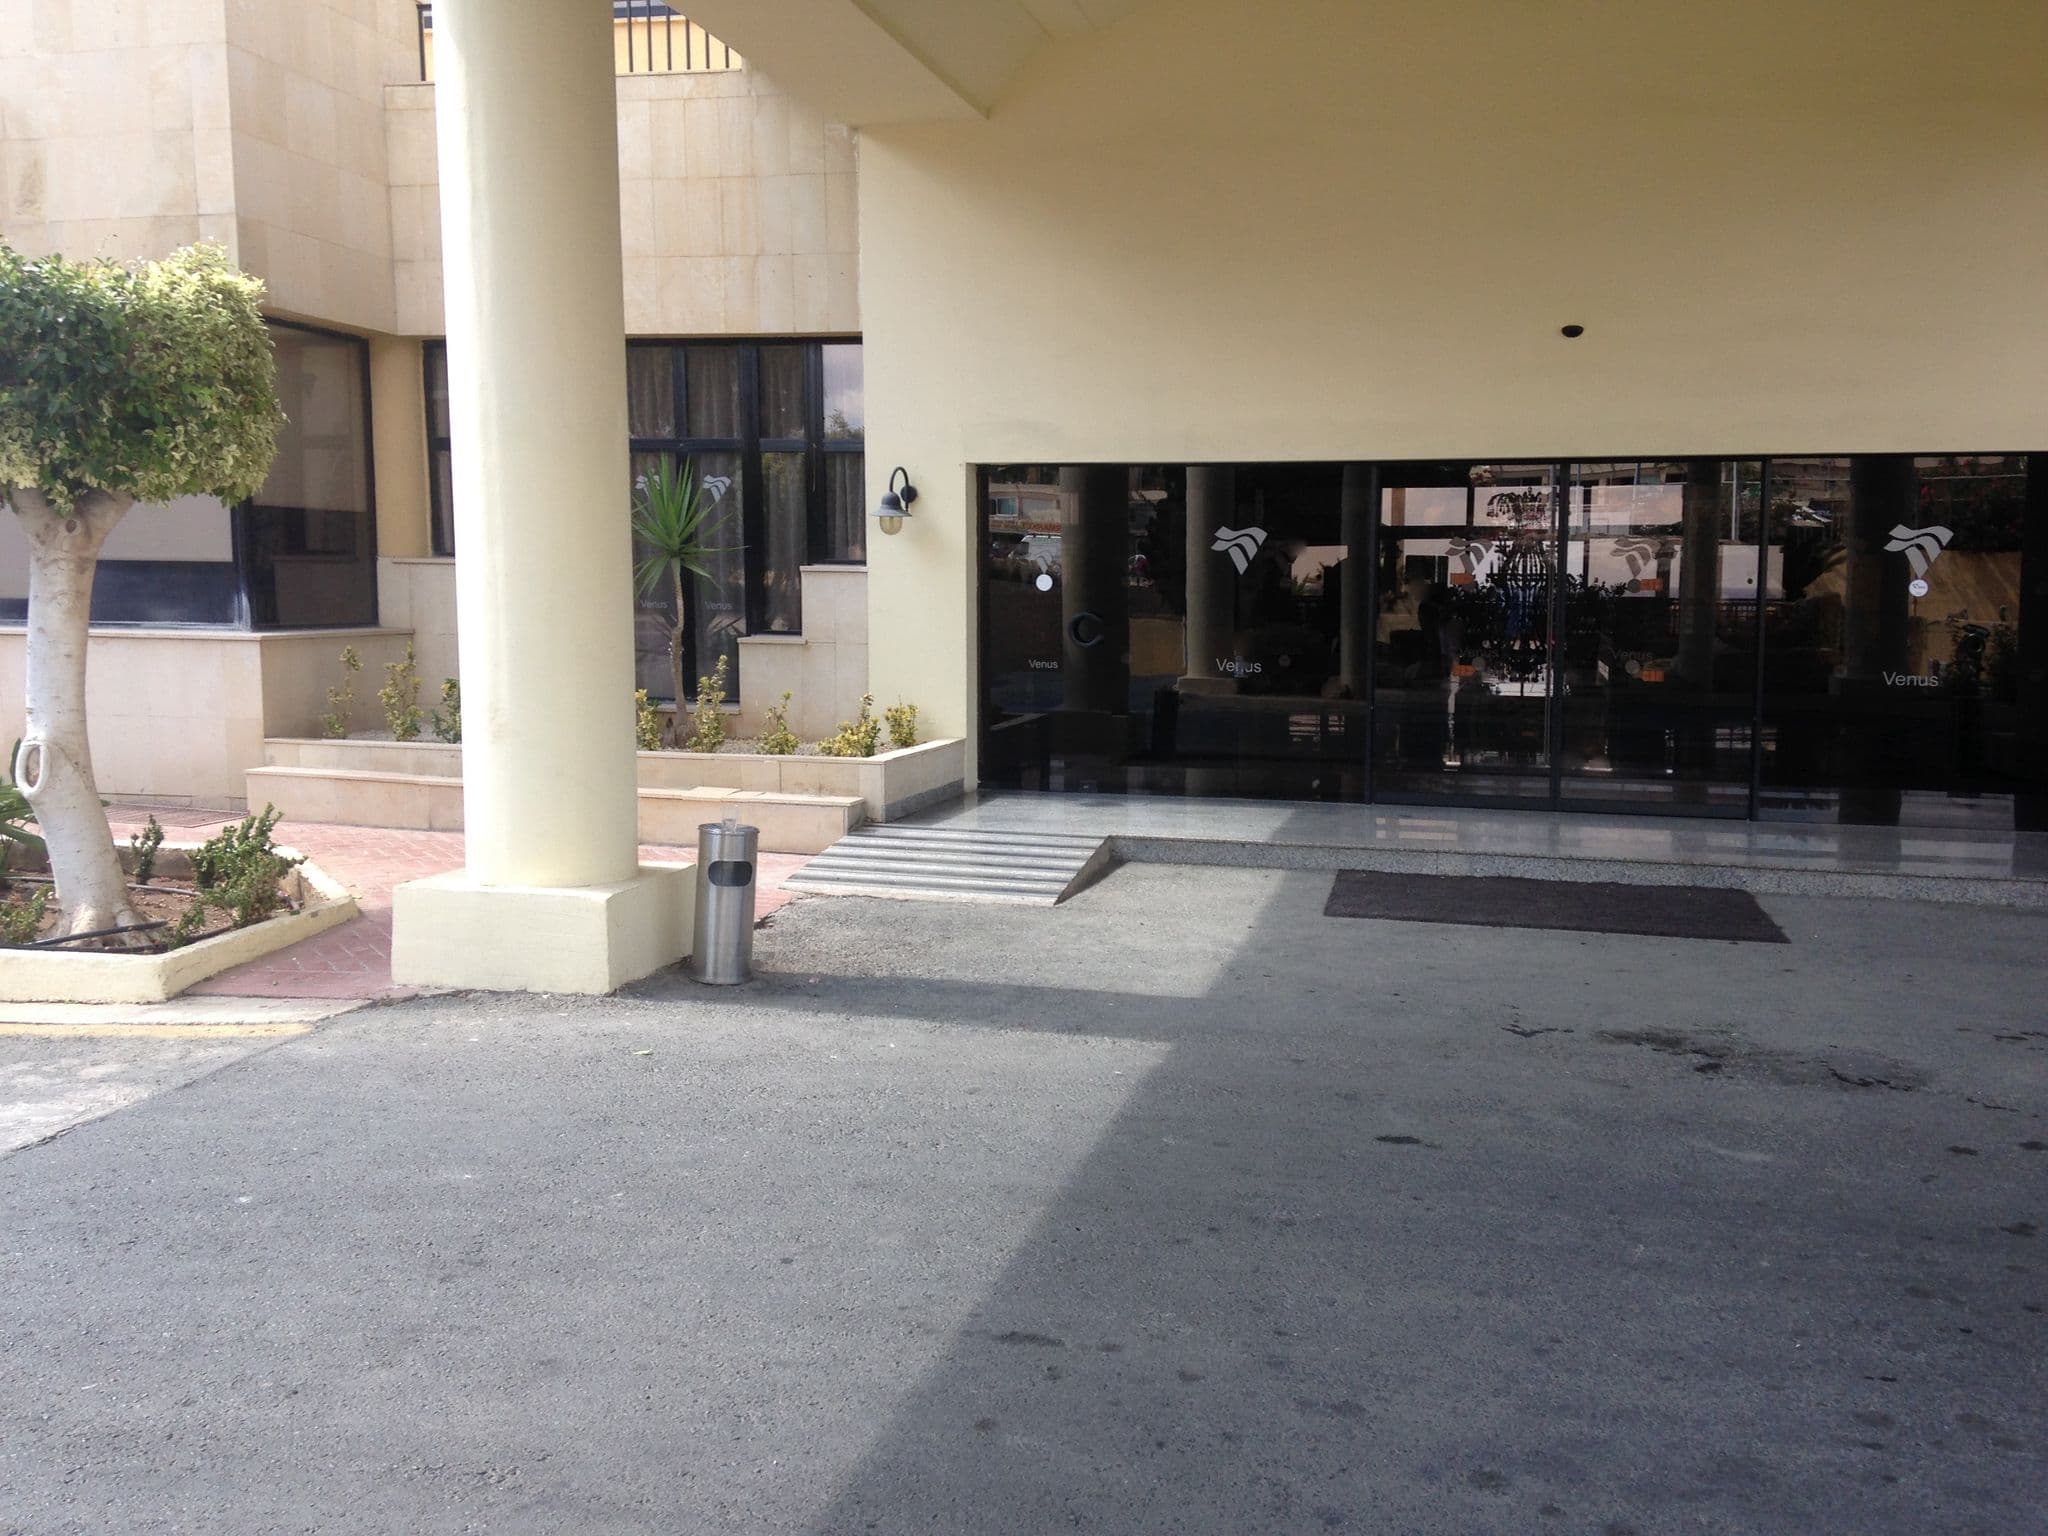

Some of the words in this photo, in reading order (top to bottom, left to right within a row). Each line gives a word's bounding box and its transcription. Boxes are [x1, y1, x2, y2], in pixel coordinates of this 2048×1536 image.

[640, 600, 668, 609] Venus
[704, 600, 733, 610] Venus
[1611, 648, 1653, 661] Venus
[1028, 659, 1058, 669] Venus
[1215, 658, 1262, 673] Venus
[1882, 671, 1939, 687] Venus
